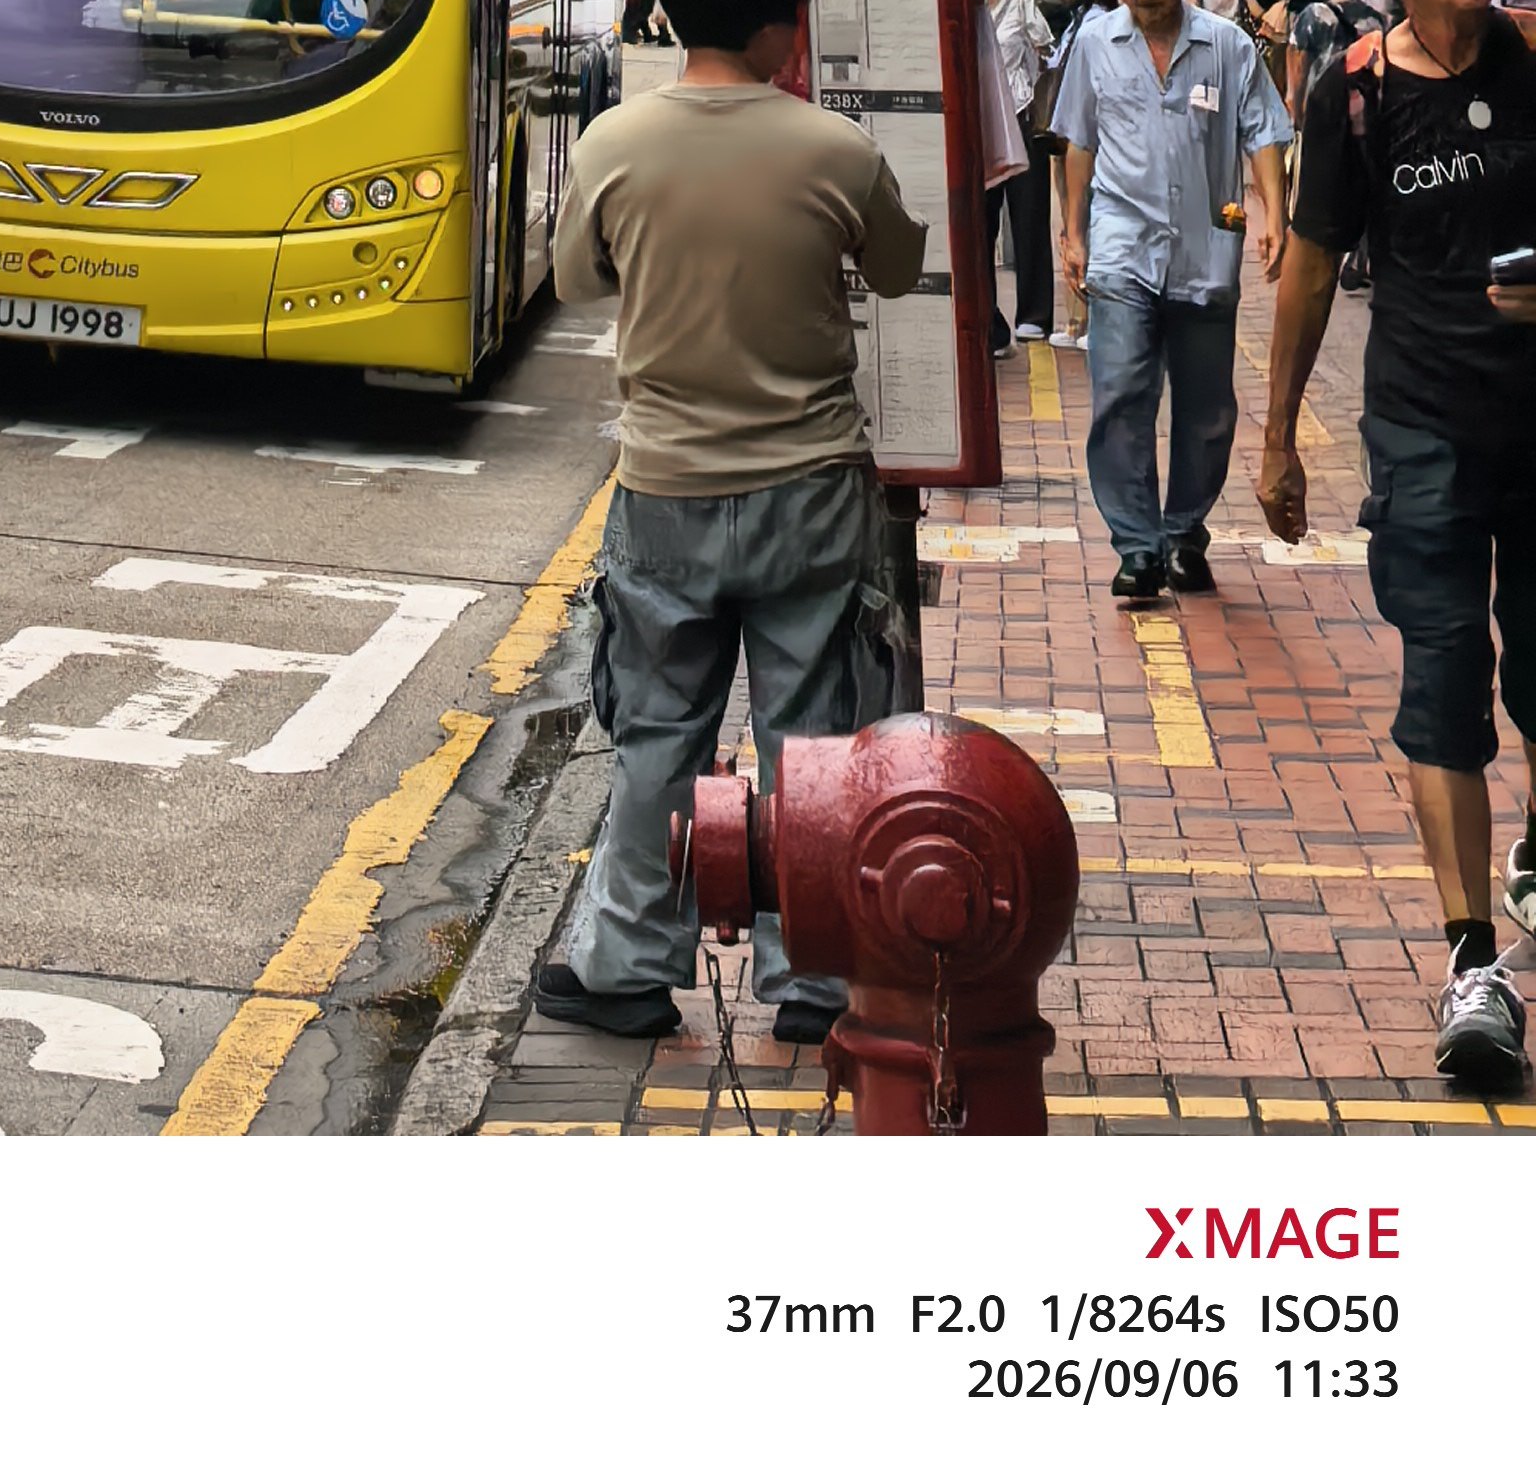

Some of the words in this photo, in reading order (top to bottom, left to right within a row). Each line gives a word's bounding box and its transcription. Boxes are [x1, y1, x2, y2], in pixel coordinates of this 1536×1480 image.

[822, 93, 864, 109] 238X
[39, 110, 102, 127] VOLVO
[1392, 148, 1485, 196] Calvin
[59, 254, 141, 281] Citybus
[48, 301, 124, 339] 1998
